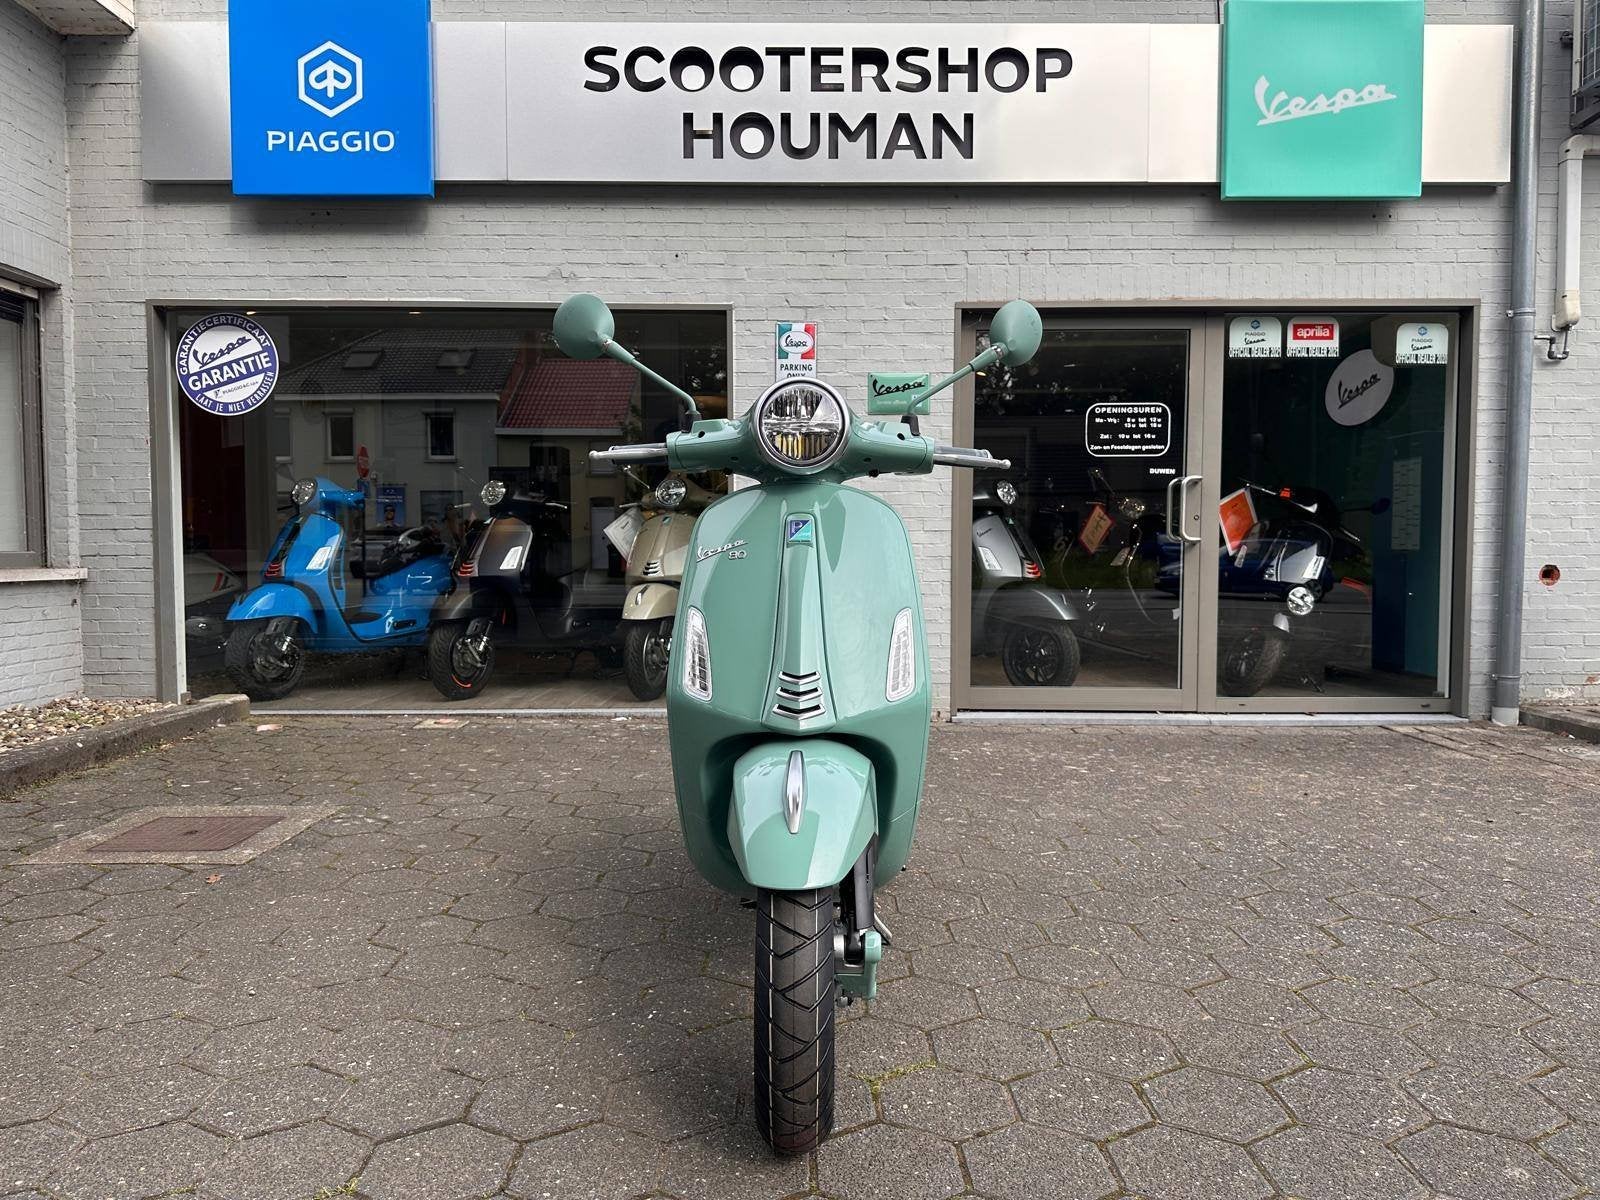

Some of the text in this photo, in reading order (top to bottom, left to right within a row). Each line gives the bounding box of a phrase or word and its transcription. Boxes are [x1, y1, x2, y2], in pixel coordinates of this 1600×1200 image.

[583, 45, 1074, 94] SCOOTERSHOP
[1254, 75, 1397, 126] Vespa
[267, 130, 395, 152] PIAGGIO
[682, 111, 974, 160] HOUMAN
[180, 315, 271, 375] GARANTIECERTIFICAAT
[784, 334, 808, 348] Vespa
[1297, 325, 1330, 338] aprilia
[192, 336, 252, 370] Vespa
[780, 363, 813, 371] PARKING
[188, 352, 272, 391] GARANTIE
[873, 378, 926, 397] Vespa
[1338, 373, 1381, 409] Vespa
[195, 393, 214, 408] LAAT
[215, 404, 223, 412] JE
[228, 402, 245, 412] NIET
[696, 540, 749, 563] Vespa
